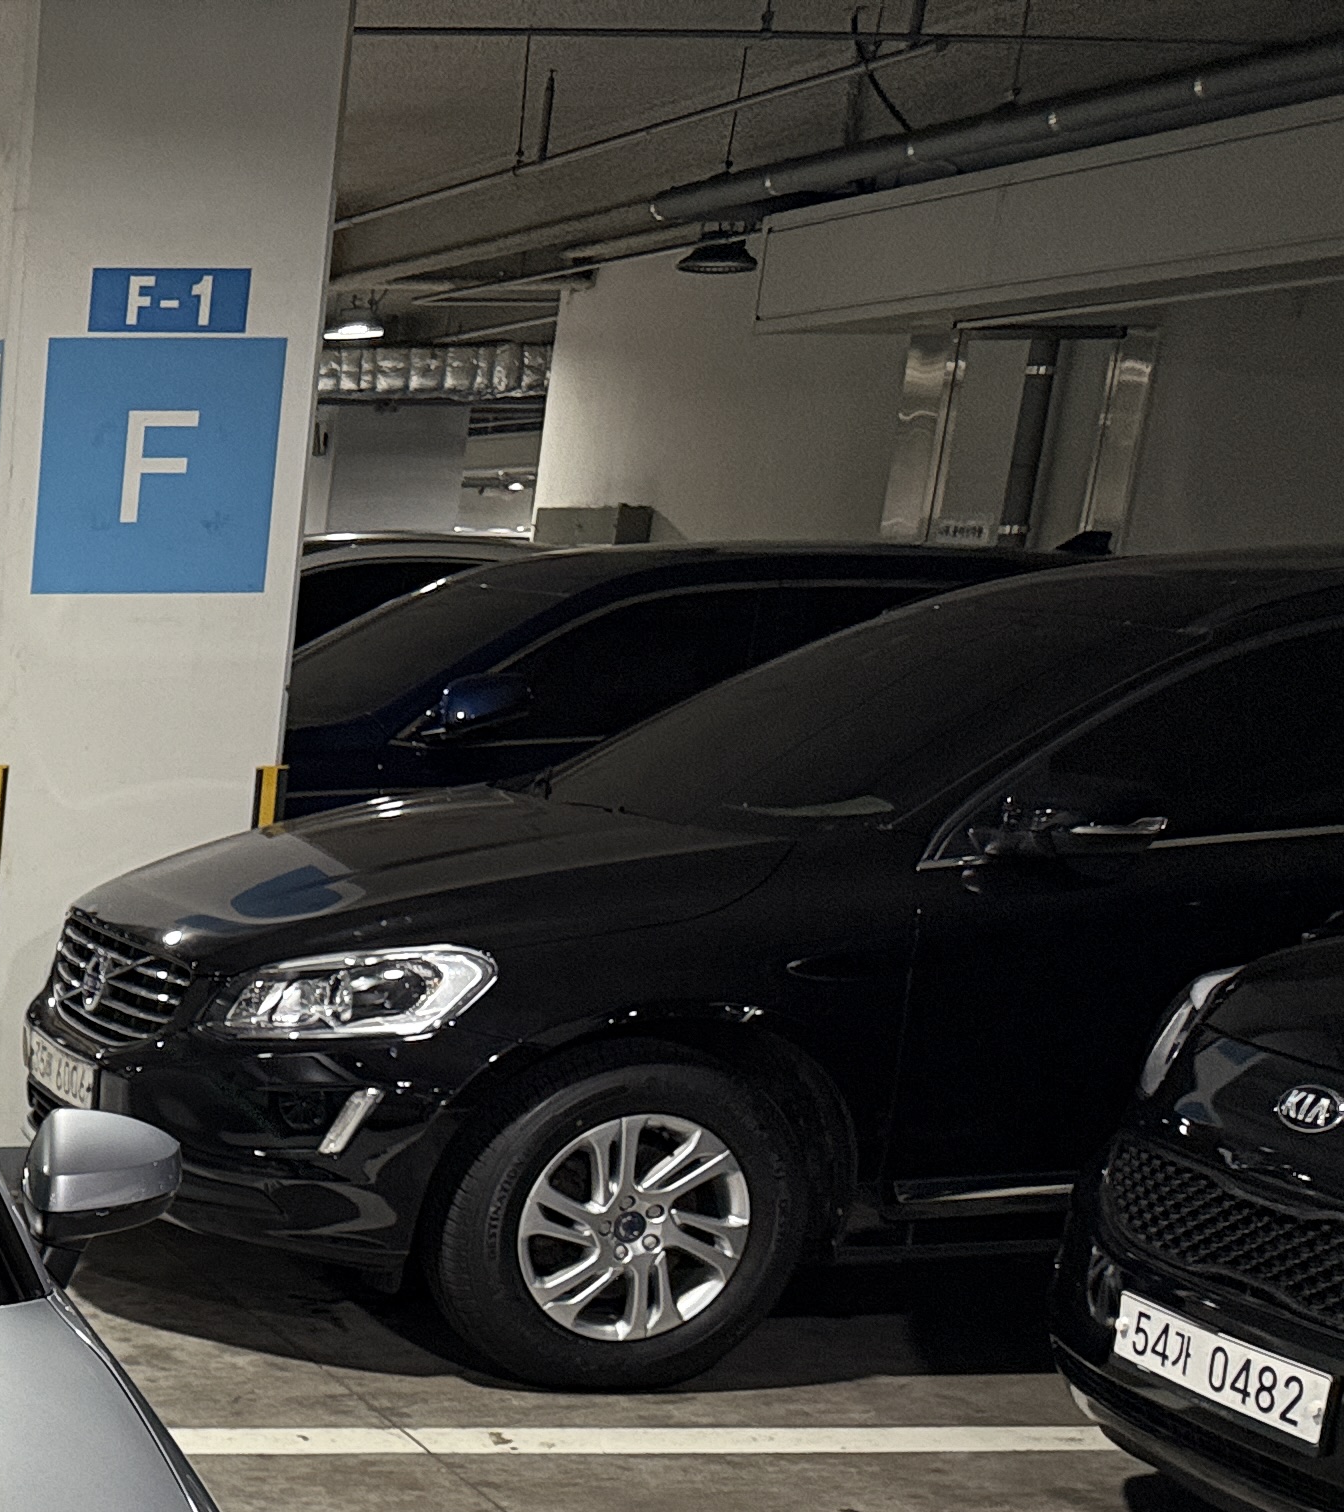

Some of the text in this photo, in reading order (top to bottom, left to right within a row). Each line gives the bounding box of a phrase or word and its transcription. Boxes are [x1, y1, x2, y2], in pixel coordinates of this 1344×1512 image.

[125, 275, 214, 327] F-1
[119, 410, 200, 524] F
[1281, 1089, 1330, 1127] KIA
[1132, 1310, 1305, 1428] 54가 0482
